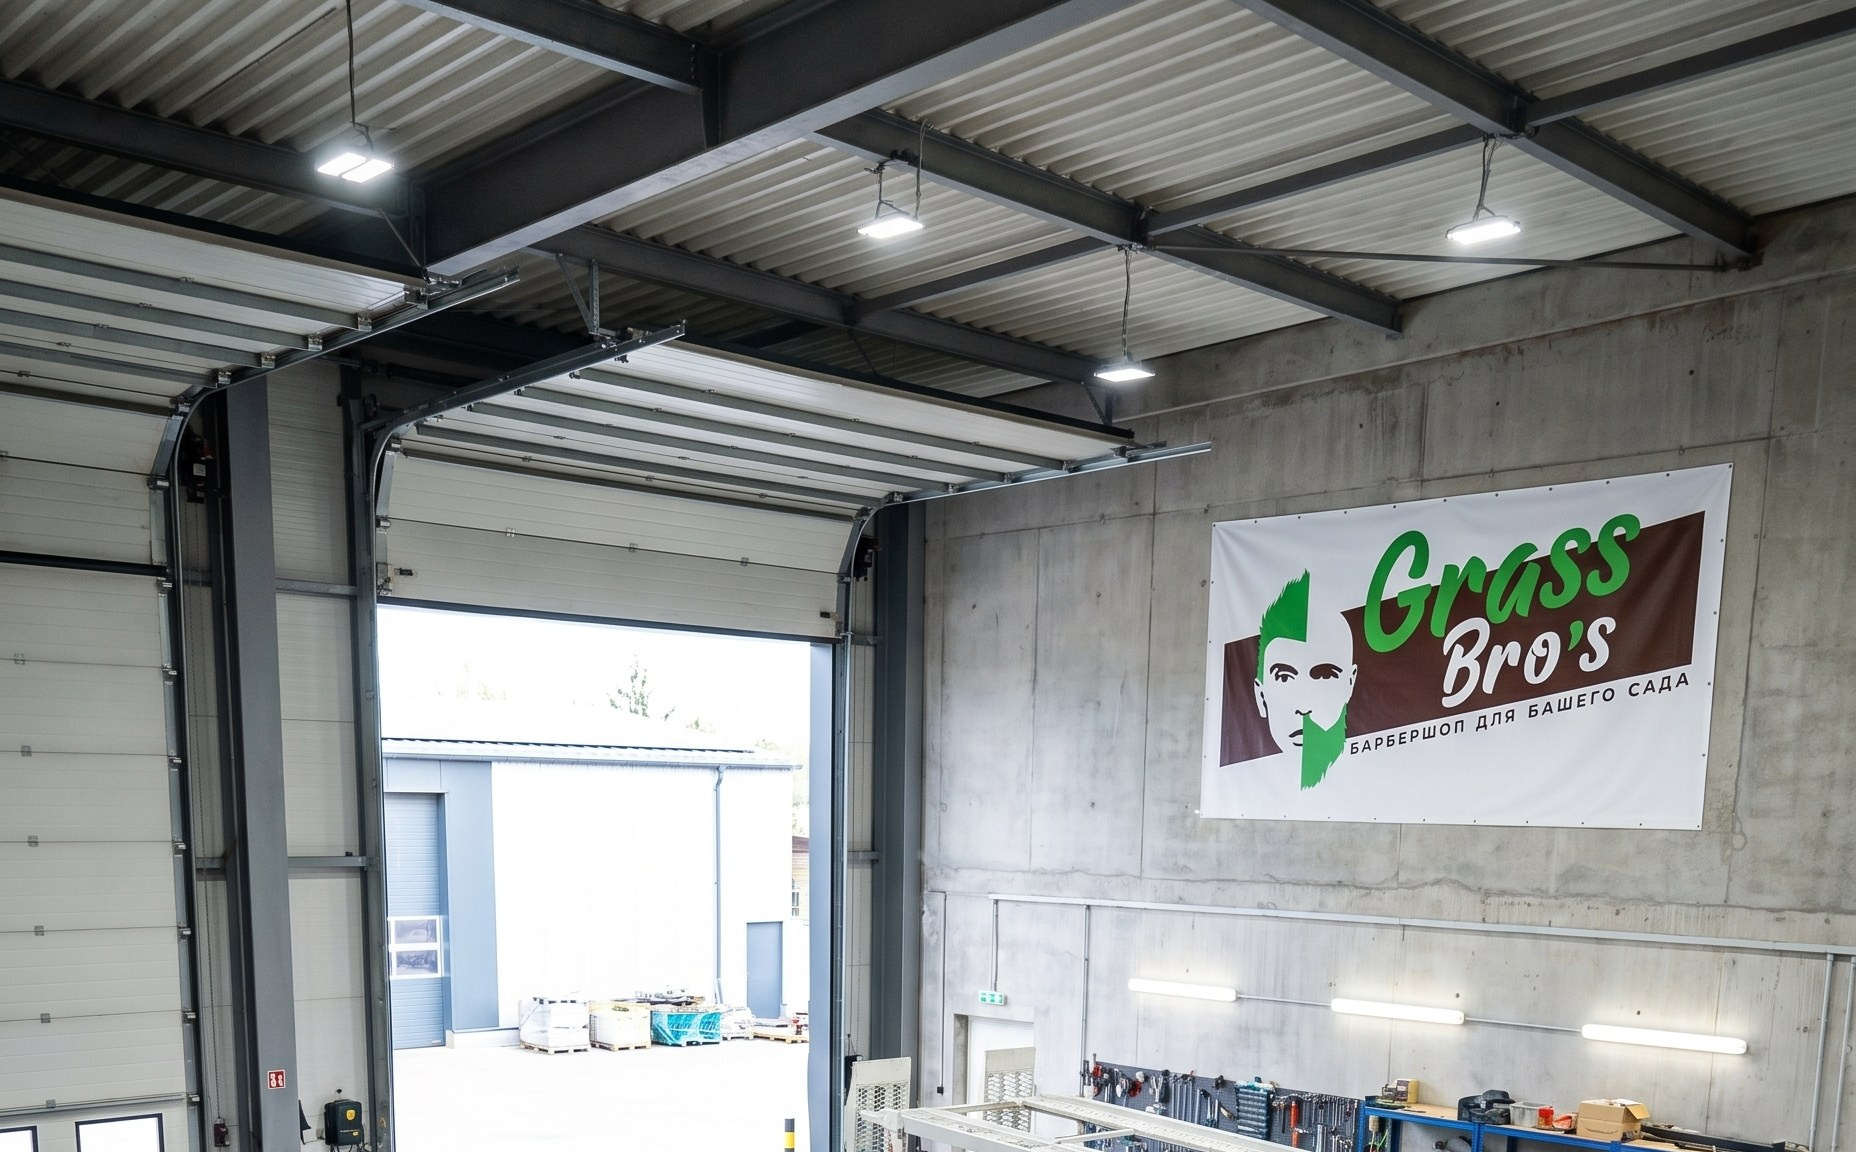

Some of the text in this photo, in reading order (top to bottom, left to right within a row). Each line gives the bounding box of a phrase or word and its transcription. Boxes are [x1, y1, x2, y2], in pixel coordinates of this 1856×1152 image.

[1364, 514, 1641, 653] Grass
[1442, 617, 1616, 708] Bro's
[1350, 672, 1689, 755] БАРБЕРШОП ДЛЯ БАШЕГО САДА
